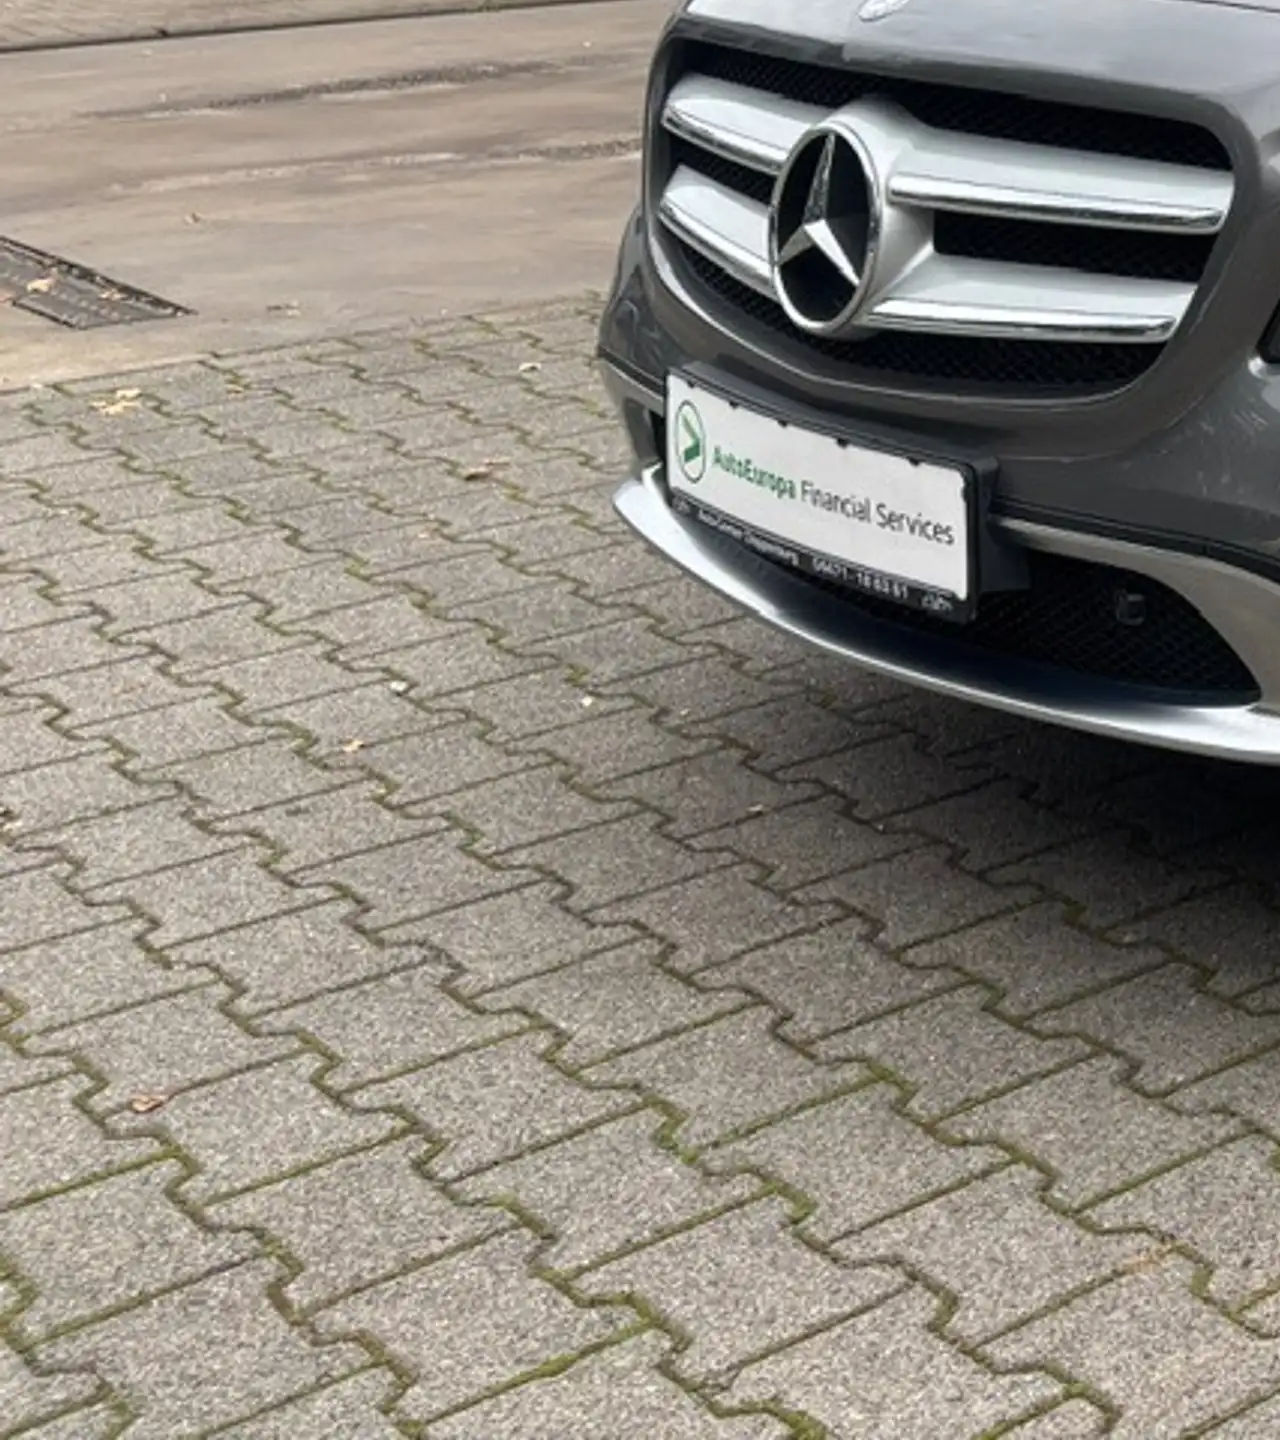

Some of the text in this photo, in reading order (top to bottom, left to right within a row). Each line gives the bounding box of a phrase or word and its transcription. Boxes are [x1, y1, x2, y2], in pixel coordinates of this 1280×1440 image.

[712, 444, 956, 546] AutoEuropa Financial Services
